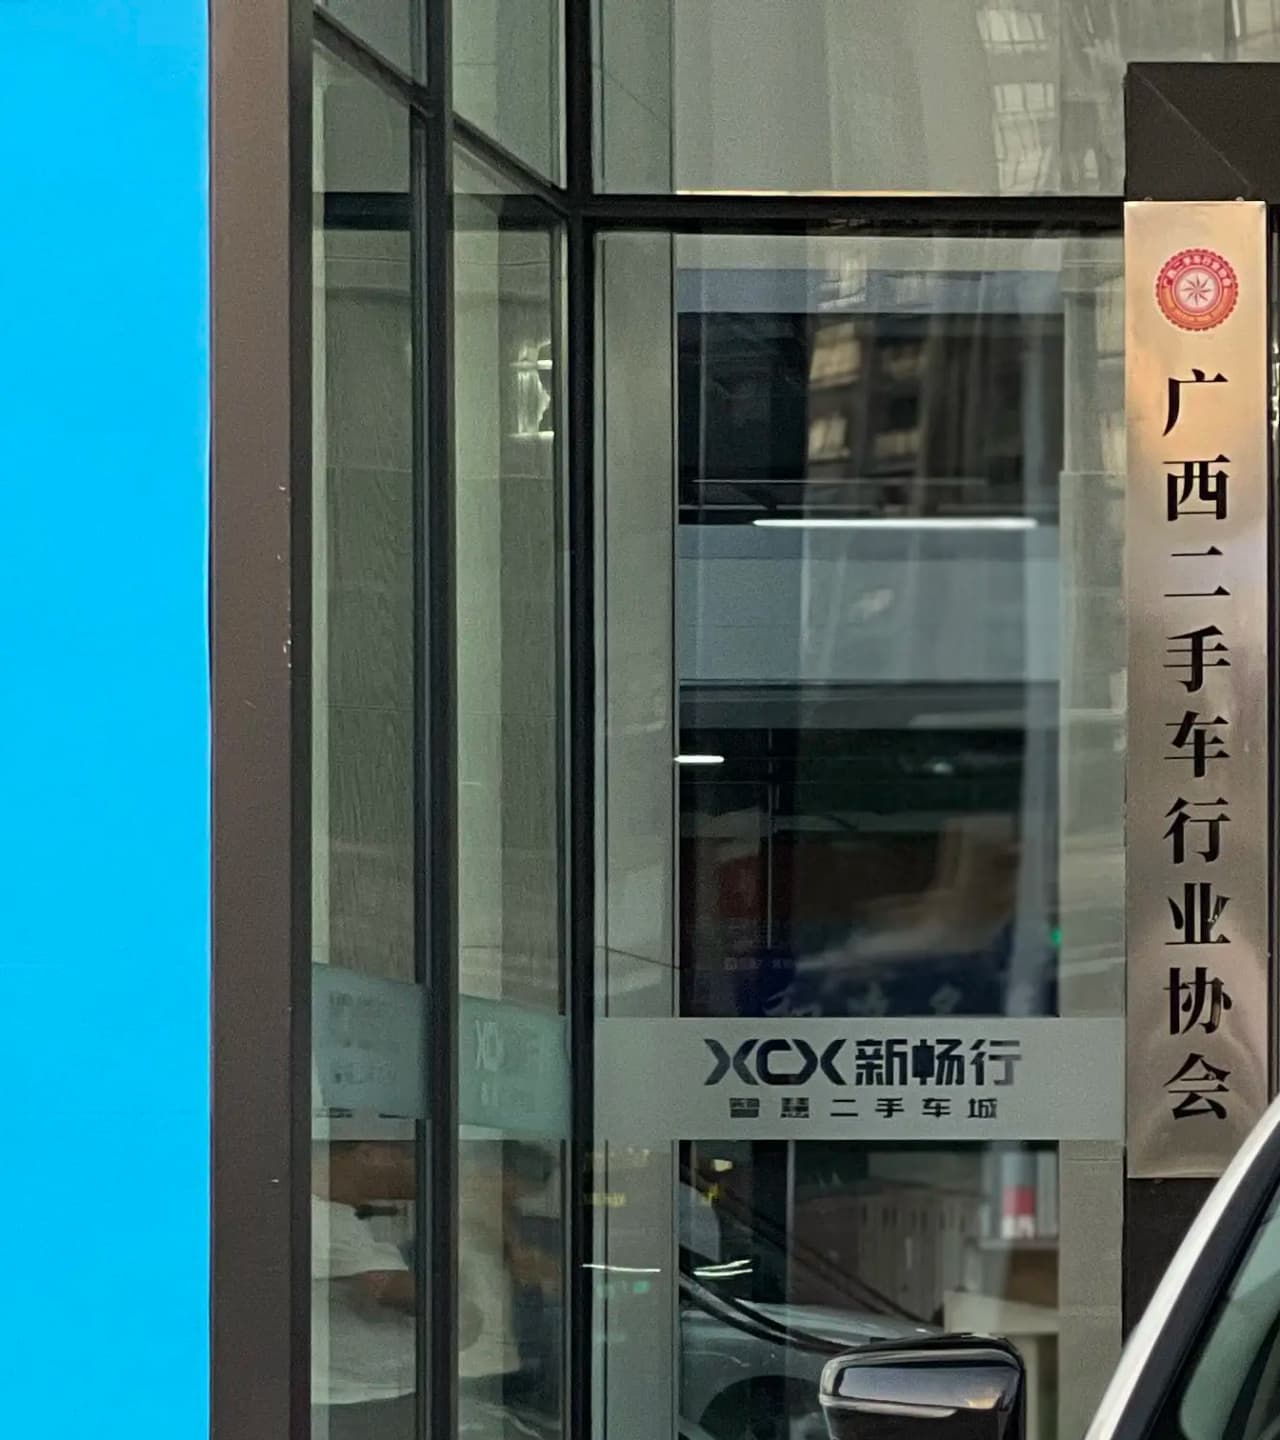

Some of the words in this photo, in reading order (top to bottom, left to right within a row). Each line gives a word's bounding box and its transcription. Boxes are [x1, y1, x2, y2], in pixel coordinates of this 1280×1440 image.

[1162, 368, 1232, 1121] 广西二手车行业协会
[854, 1038, 1024, 1087] 新畅行
[728, 1096, 999, 1120] 智慧二手车城
